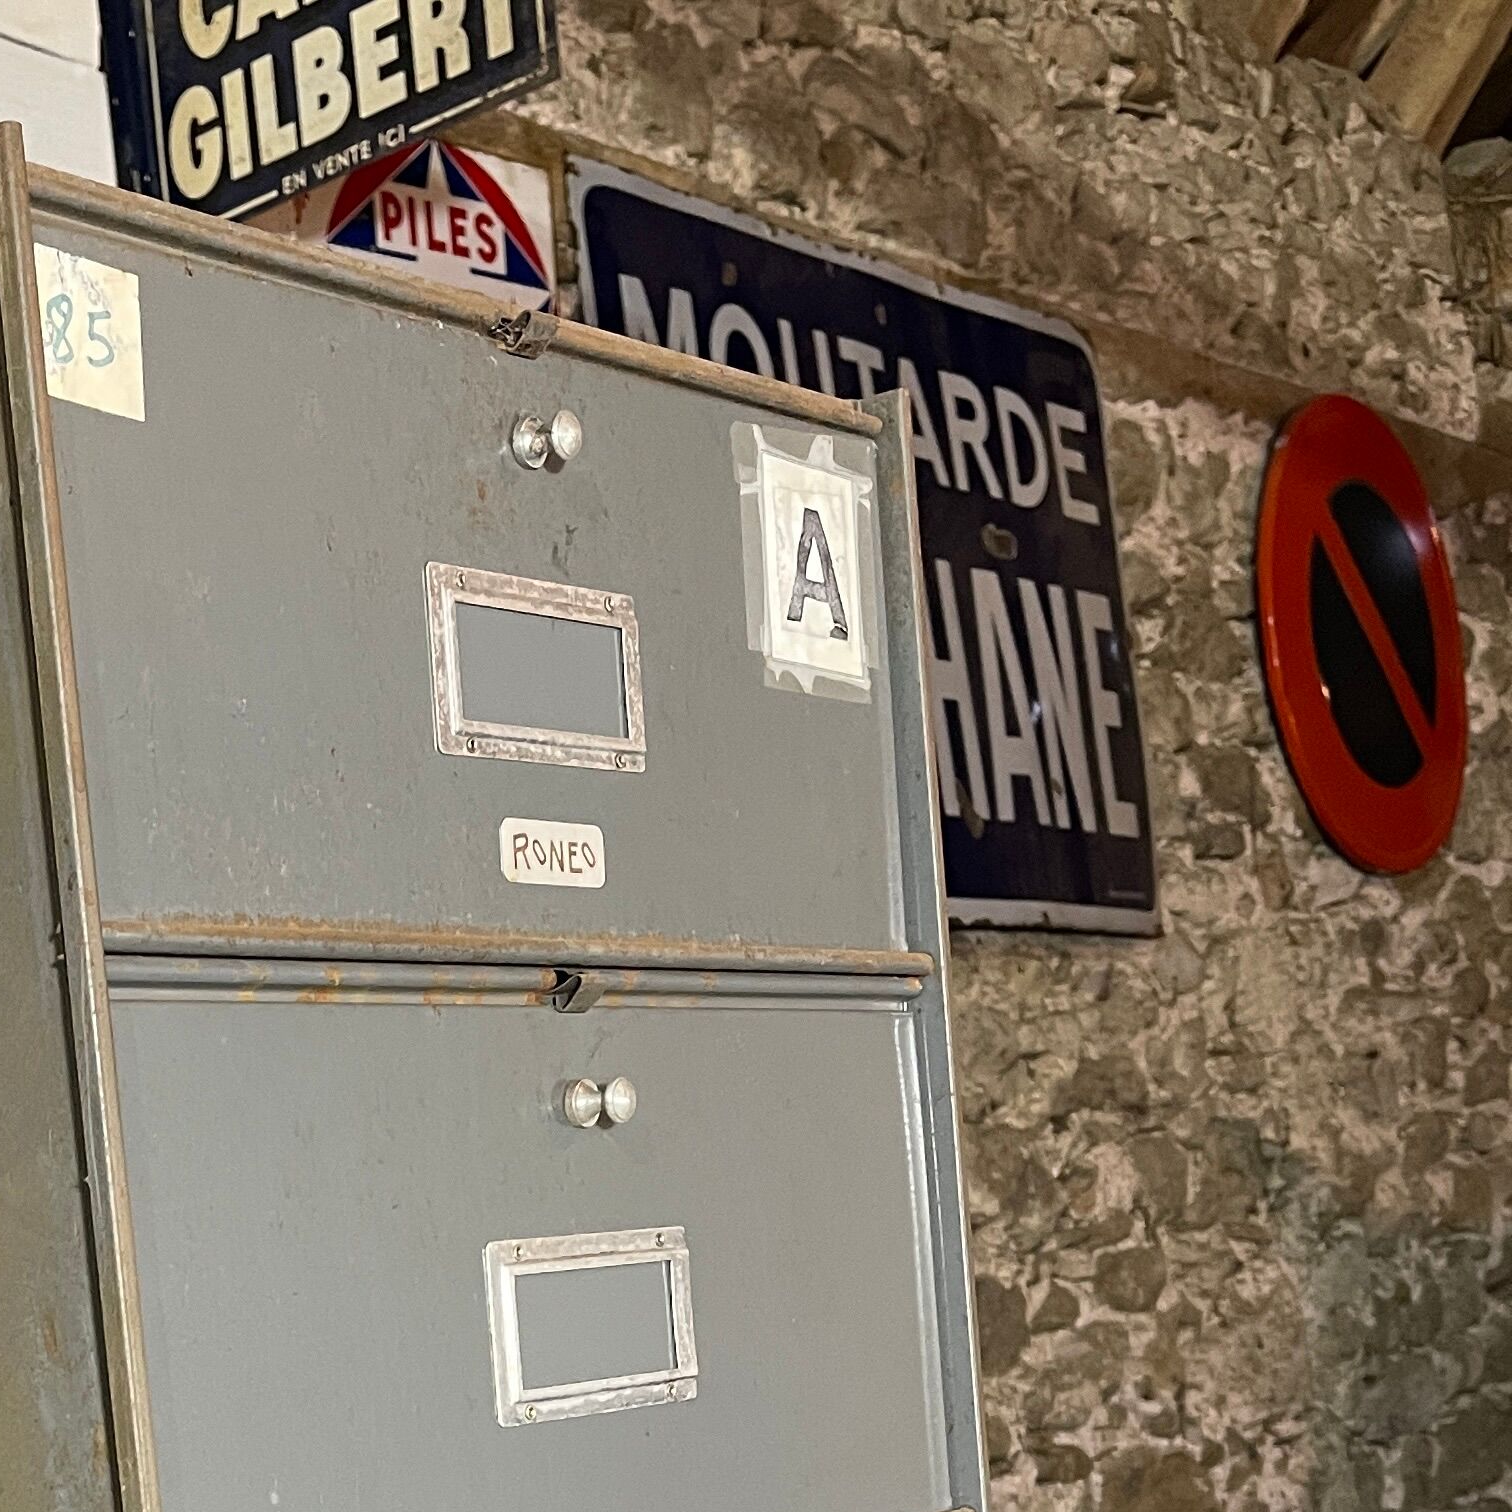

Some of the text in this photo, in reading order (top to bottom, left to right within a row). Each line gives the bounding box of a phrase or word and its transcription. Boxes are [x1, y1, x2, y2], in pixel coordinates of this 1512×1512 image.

[281, 123, 406, 195] EN VENTE ICI
[379, 191, 498, 264] PILES
[45, 293, 115, 368] 85
[787, 507, 848, 640] A
[513, 832, 596, 874] RONEO
